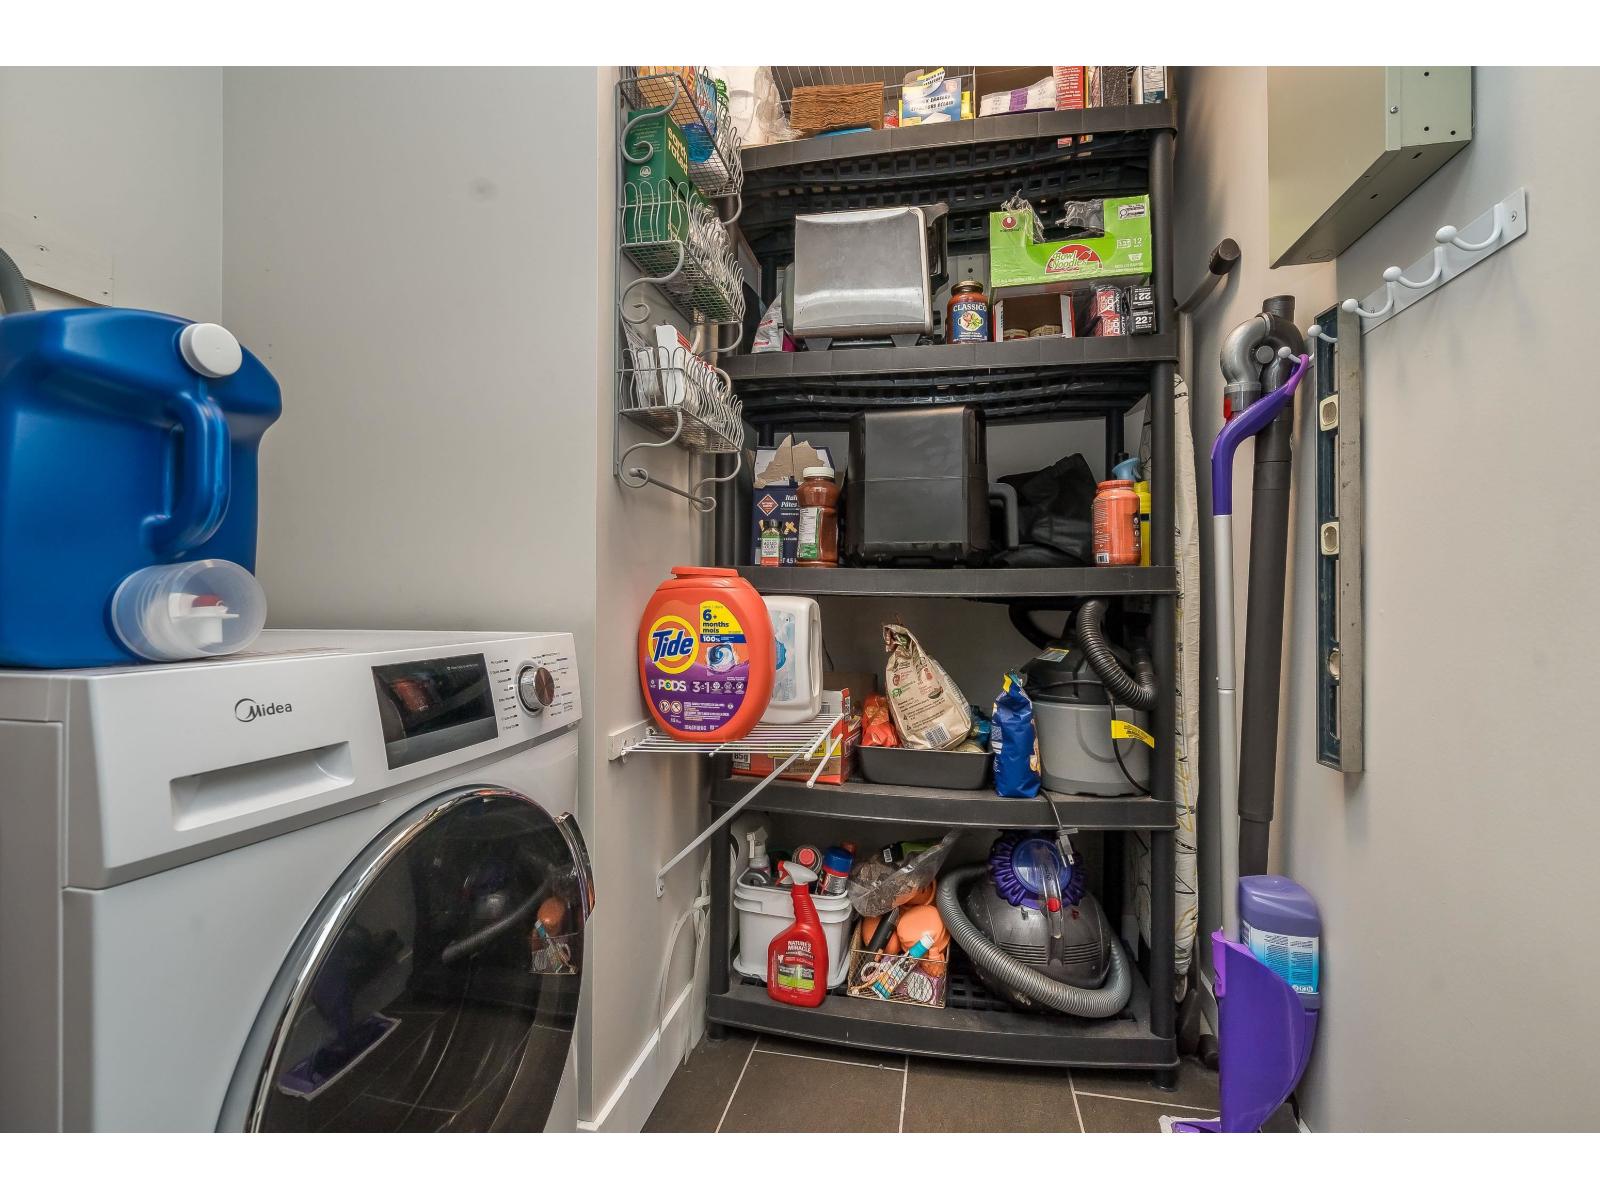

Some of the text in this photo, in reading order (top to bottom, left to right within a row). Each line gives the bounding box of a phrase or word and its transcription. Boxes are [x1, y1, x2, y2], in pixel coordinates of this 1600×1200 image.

[1053, 249, 1078, 261] Bowl
[953, 303, 987, 312] CLASSICO
[1135, 316, 1148, 325] 22
[652, 629, 695, 663] Tide
[658, 679, 687, 692] PODS
[236, 699, 293, 722] Midea
